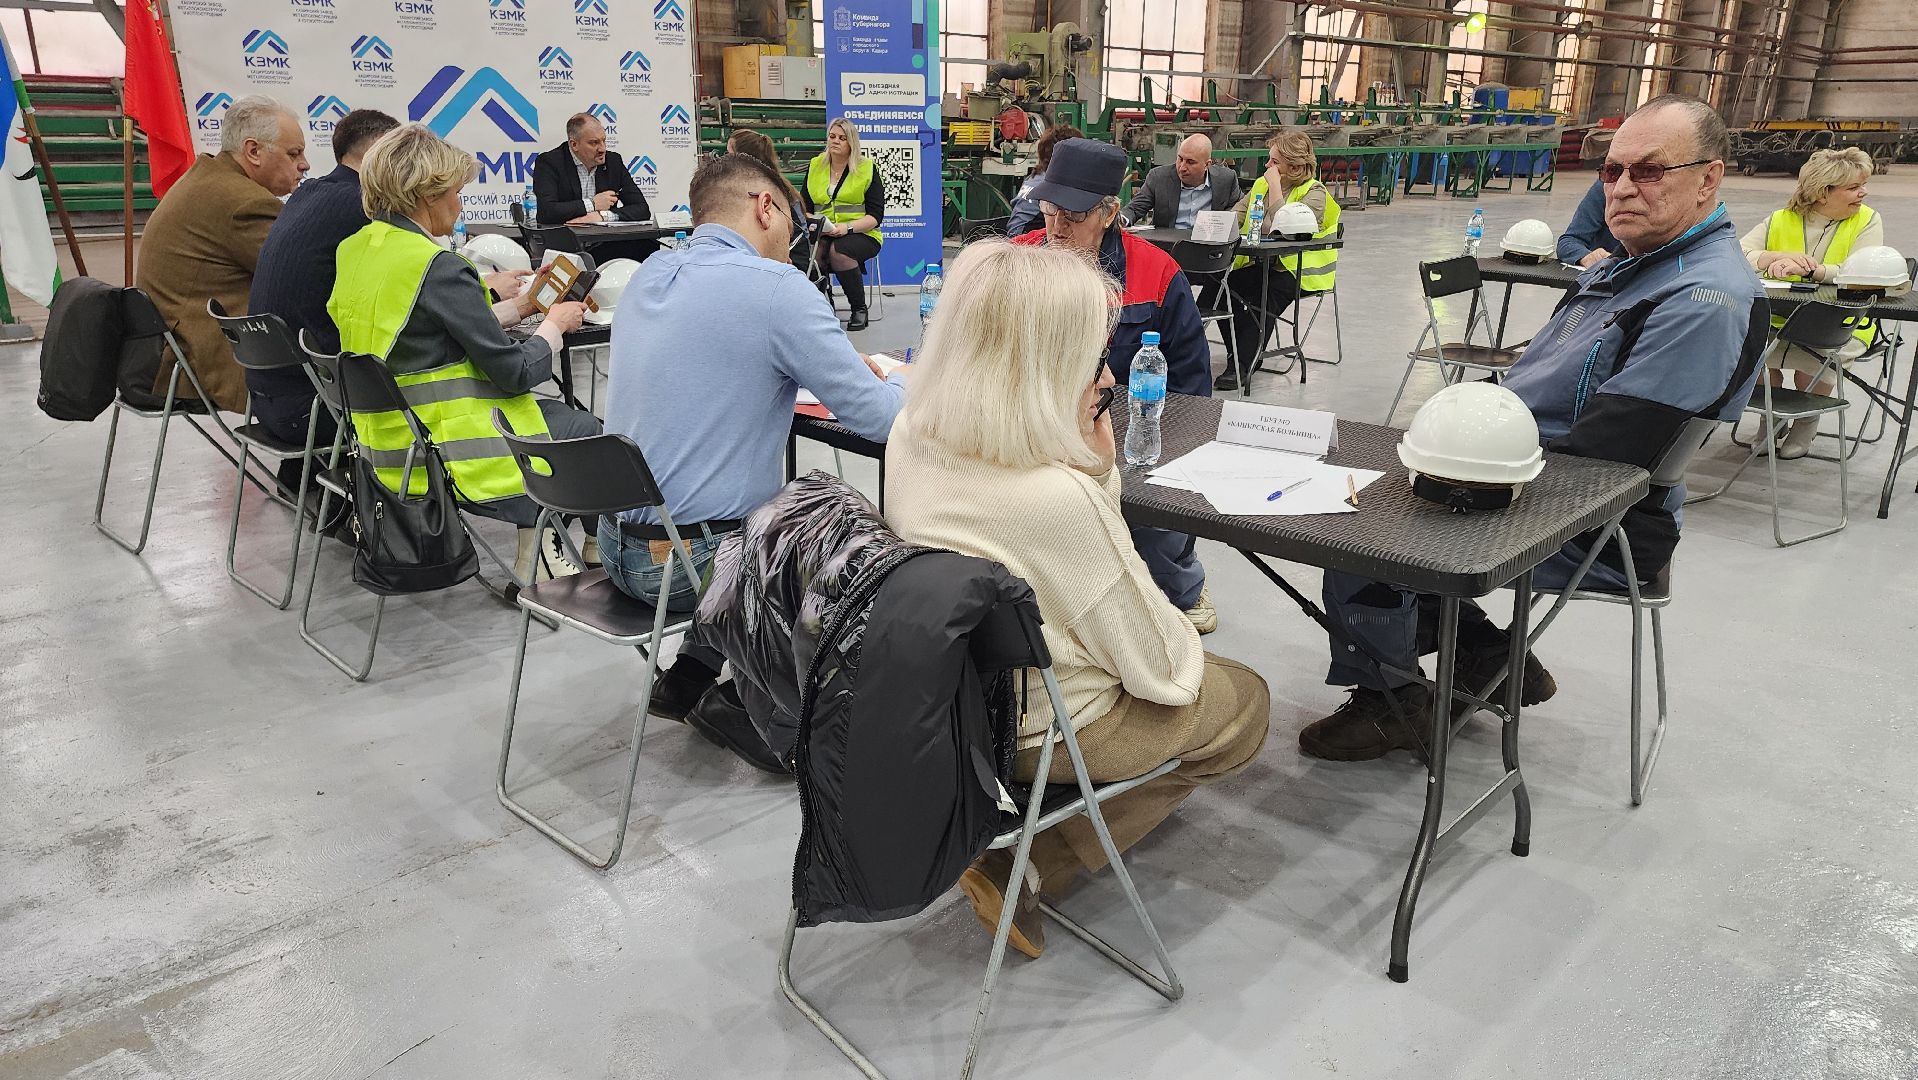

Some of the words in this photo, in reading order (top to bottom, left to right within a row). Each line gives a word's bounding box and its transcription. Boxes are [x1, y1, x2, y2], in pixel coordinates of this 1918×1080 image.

[395, 2, 435, 15] КЗМК
[489, 9, 526, 22] КЗМК
[575, 15, 609, 27] КЗМК
[654, 21, 685, 32] КЗМК
[244, 56, 291, 69] КЗМК
[352, 60, 395, 73] КЗМК
[539, 69, 574, 80] КЗМК
[620, 72, 651, 83] КЗМК
[844, 110, 924, 121] ОБЪЕДИНЯЕМСЯ
[197, 118, 223, 130] КЗ
[873, 125, 919, 134] ПЕРЕМЕН
[661, 126, 690, 135] КЗМК
[476, 152, 540, 184] МК
[632, 176, 658, 185] ЗМК
[500, 194, 522, 205] ЗАВ
